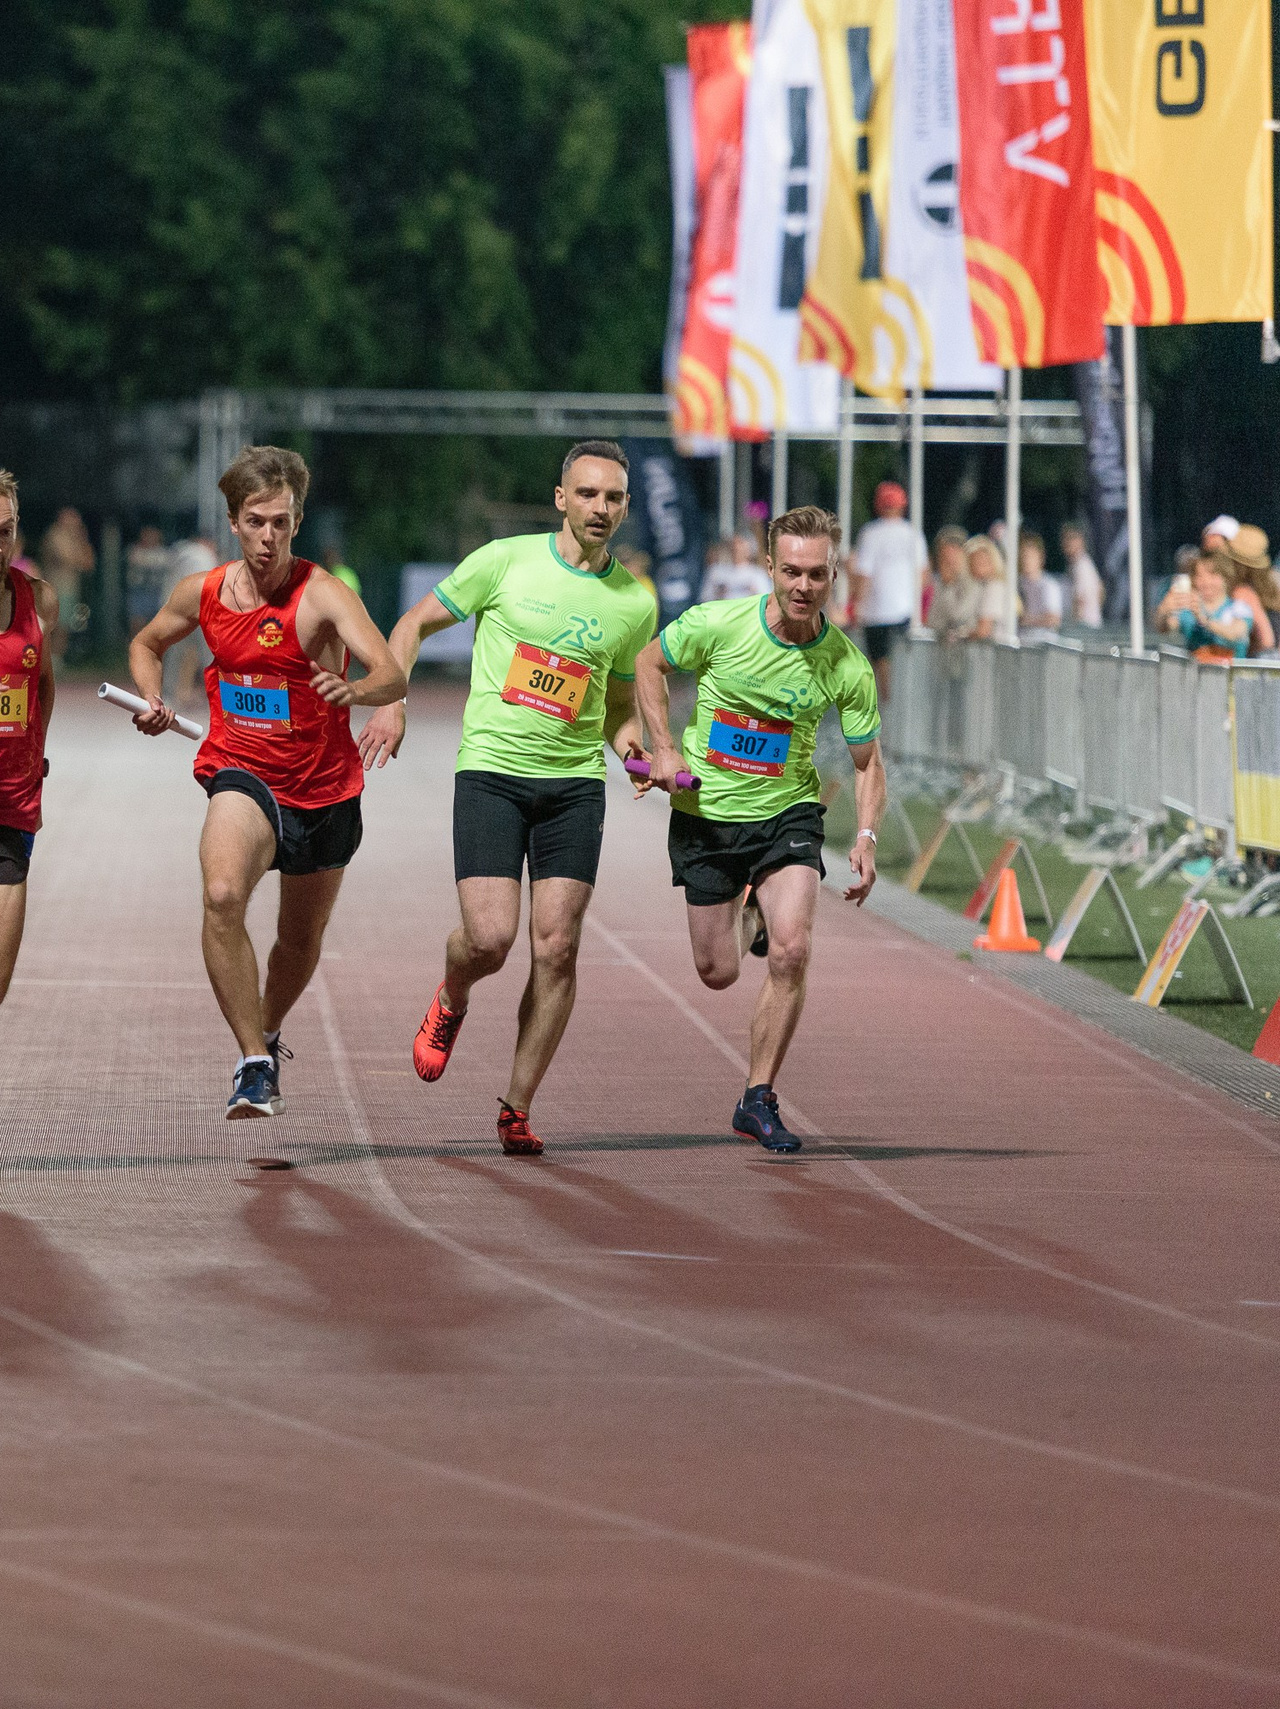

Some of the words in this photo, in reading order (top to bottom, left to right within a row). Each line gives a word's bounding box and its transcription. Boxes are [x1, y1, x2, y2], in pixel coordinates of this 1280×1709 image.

[528, 669, 566, 695] 307
[568, 691, 576, 702] 2
[16, 704, 21, 715] 2
[235, 691, 266, 713] 308
[274, 703, 280, 714] 3
[536, 699, 545, 707] 100
[731, 733, 768, 756] 307
[773, 747, 779, 758] 3
[729, 759, 740, 767] этап
